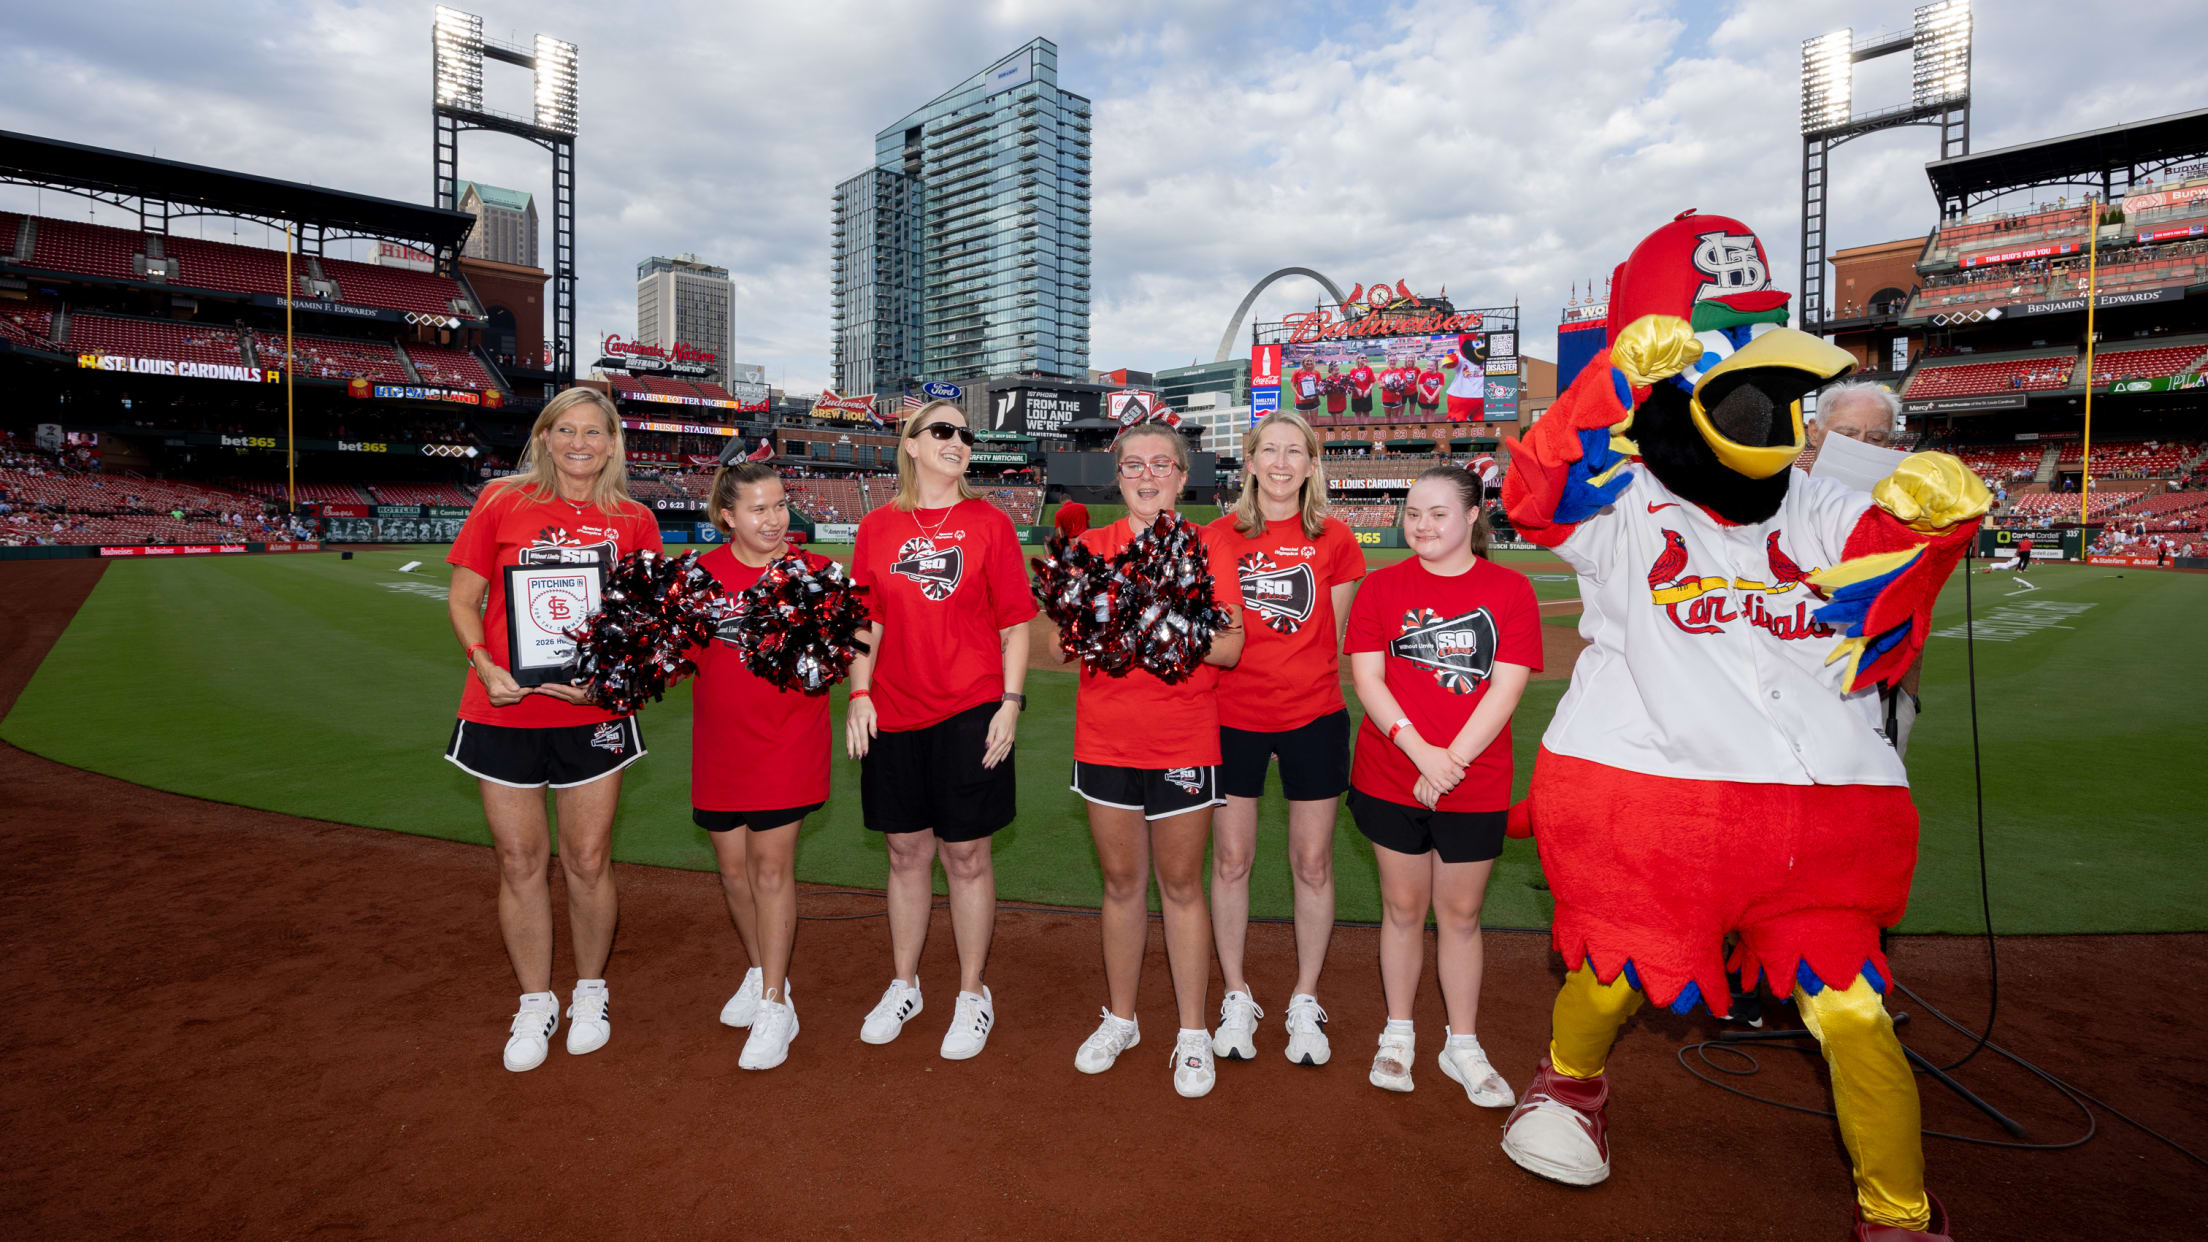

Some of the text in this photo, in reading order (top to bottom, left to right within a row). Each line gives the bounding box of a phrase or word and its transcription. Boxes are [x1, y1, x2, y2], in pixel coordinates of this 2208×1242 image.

[1986, 248, 2051, 263] THIS BUD'S FOR YOU
[2028, 300, 2085, 313] BENJAMIN
[1283, 308, 1484, 343] Budweiser
[605, 334, 714, 363] Cardinals Nation
[104, 356, 127, 371] ST.
[129, 358, 175, 376] LOUIS
[178, 362, 261, 383] CARDINALS
[625, 359, 706, 374] HOFFMANN ROOFTOP
[1486, 364, 1517, 372] DISASTER
[1253, 375, 1279, 385] Coca-Cola
[375, 386, 479, 405] BIG MAC LAND
[931, 383, 954, 396] Ford
[633, 392, 728, 408] HARRY POTTER NIGHT
[1026, 399, 1080, 411] FROM THE
[812, 408, 840, 418] BREW
[1026, 409, 1072, 422] LOU AND
[639, 422, 722, 435] AT BUSCH STADIUM
[1026, 420, 1058, 431] WE'RE
[1342, 431, 1351, 440] 14
[1357, 431, 1367, 440] 17
[1373, 430, 1386, 440] 20
[1394, 430, 1407, 439] 23
[1413, 429, 1427, 439] 24
[1432, 428, 1446, 438] 42
[1453, 428, 1466, 438] 45
[221, 435, 276, 448] bet365
[338, 441, 387, 453] bet365
[1330, 479, 1412, 489] ST. LOUIS CARDINALS
[100, 547, 133, 556] Budweiser
[145, 546, 174, 555] Budweiser
[184, 546, 211, 554] Budweiser
[531, 579, 583, 588] PITCHING IN
